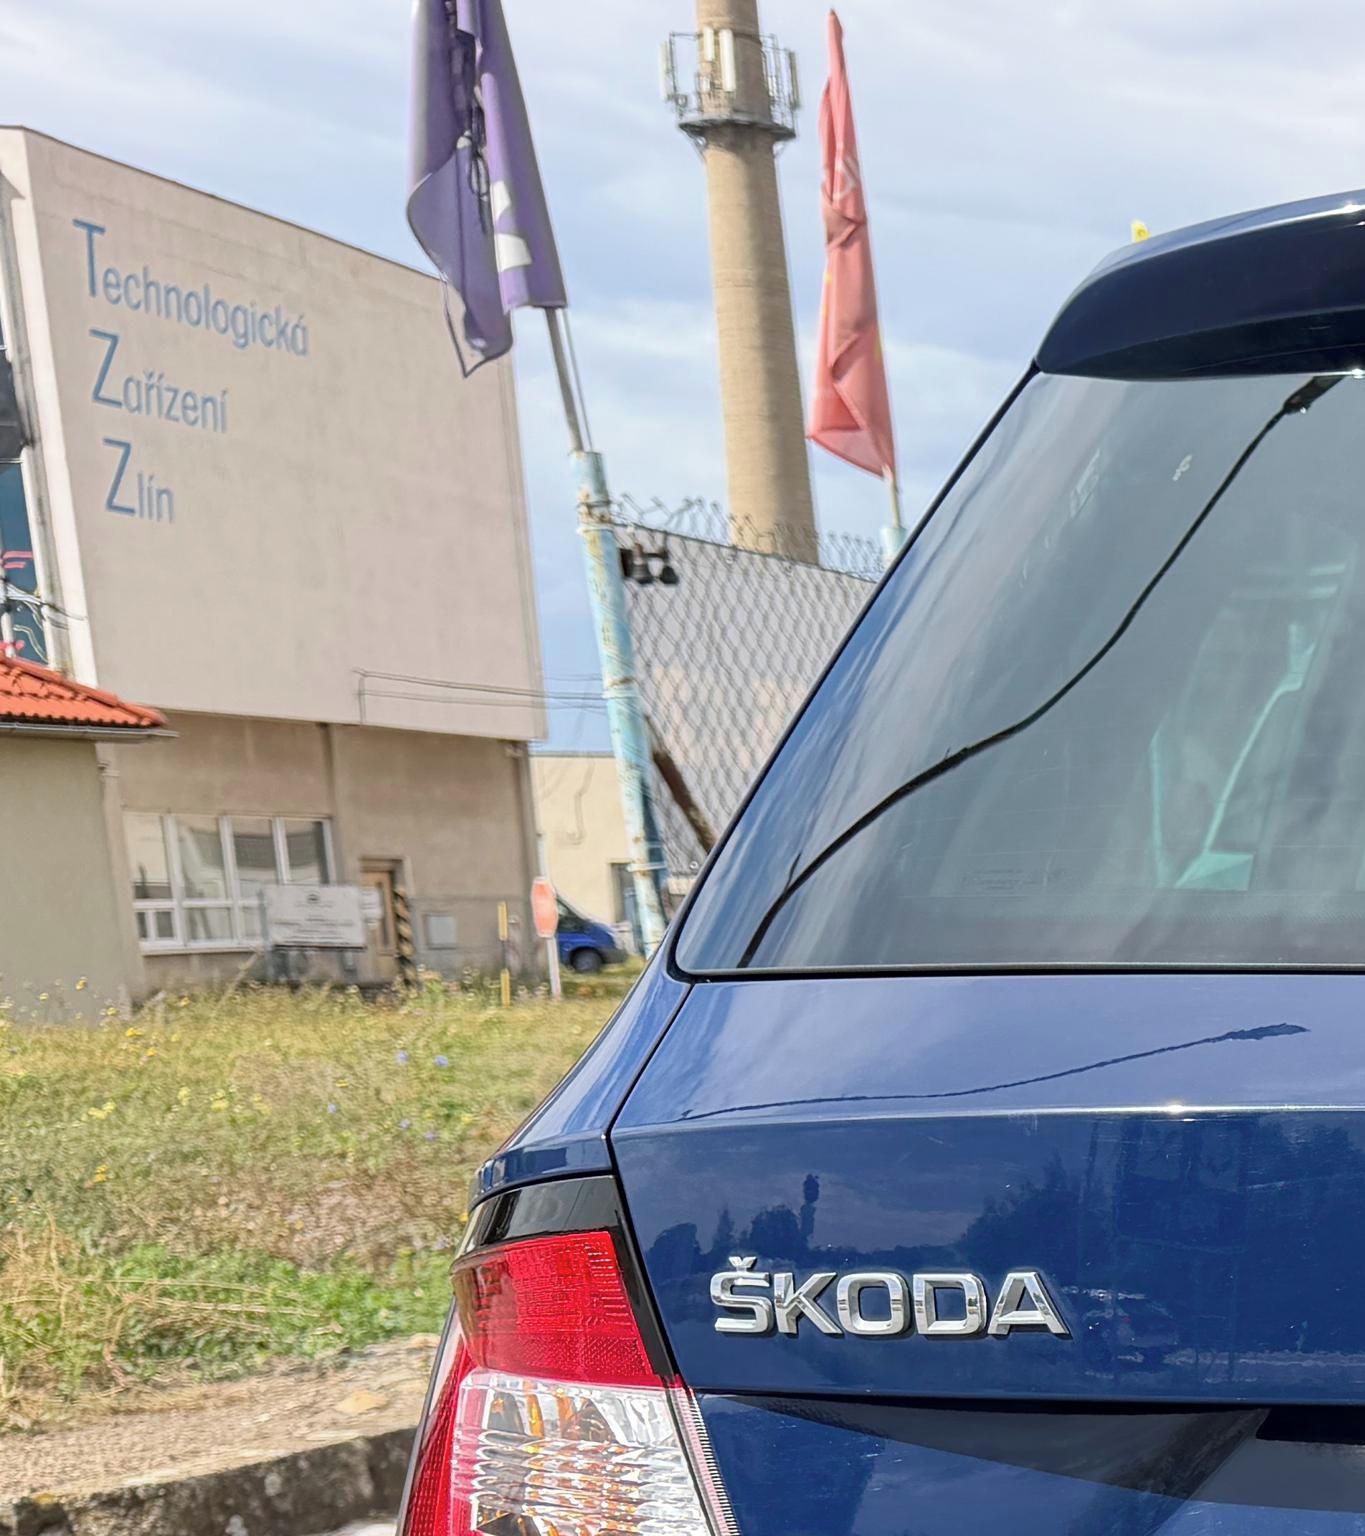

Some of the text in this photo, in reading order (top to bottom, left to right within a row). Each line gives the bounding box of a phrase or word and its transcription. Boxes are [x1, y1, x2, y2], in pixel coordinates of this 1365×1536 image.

[72, 218, 309, 356] Technologická
[88, 328, 228, 433] Zařízení
[102, 437, 175, 524] Zlín
[710, 1255, 1072, 1336] ŠKODA
